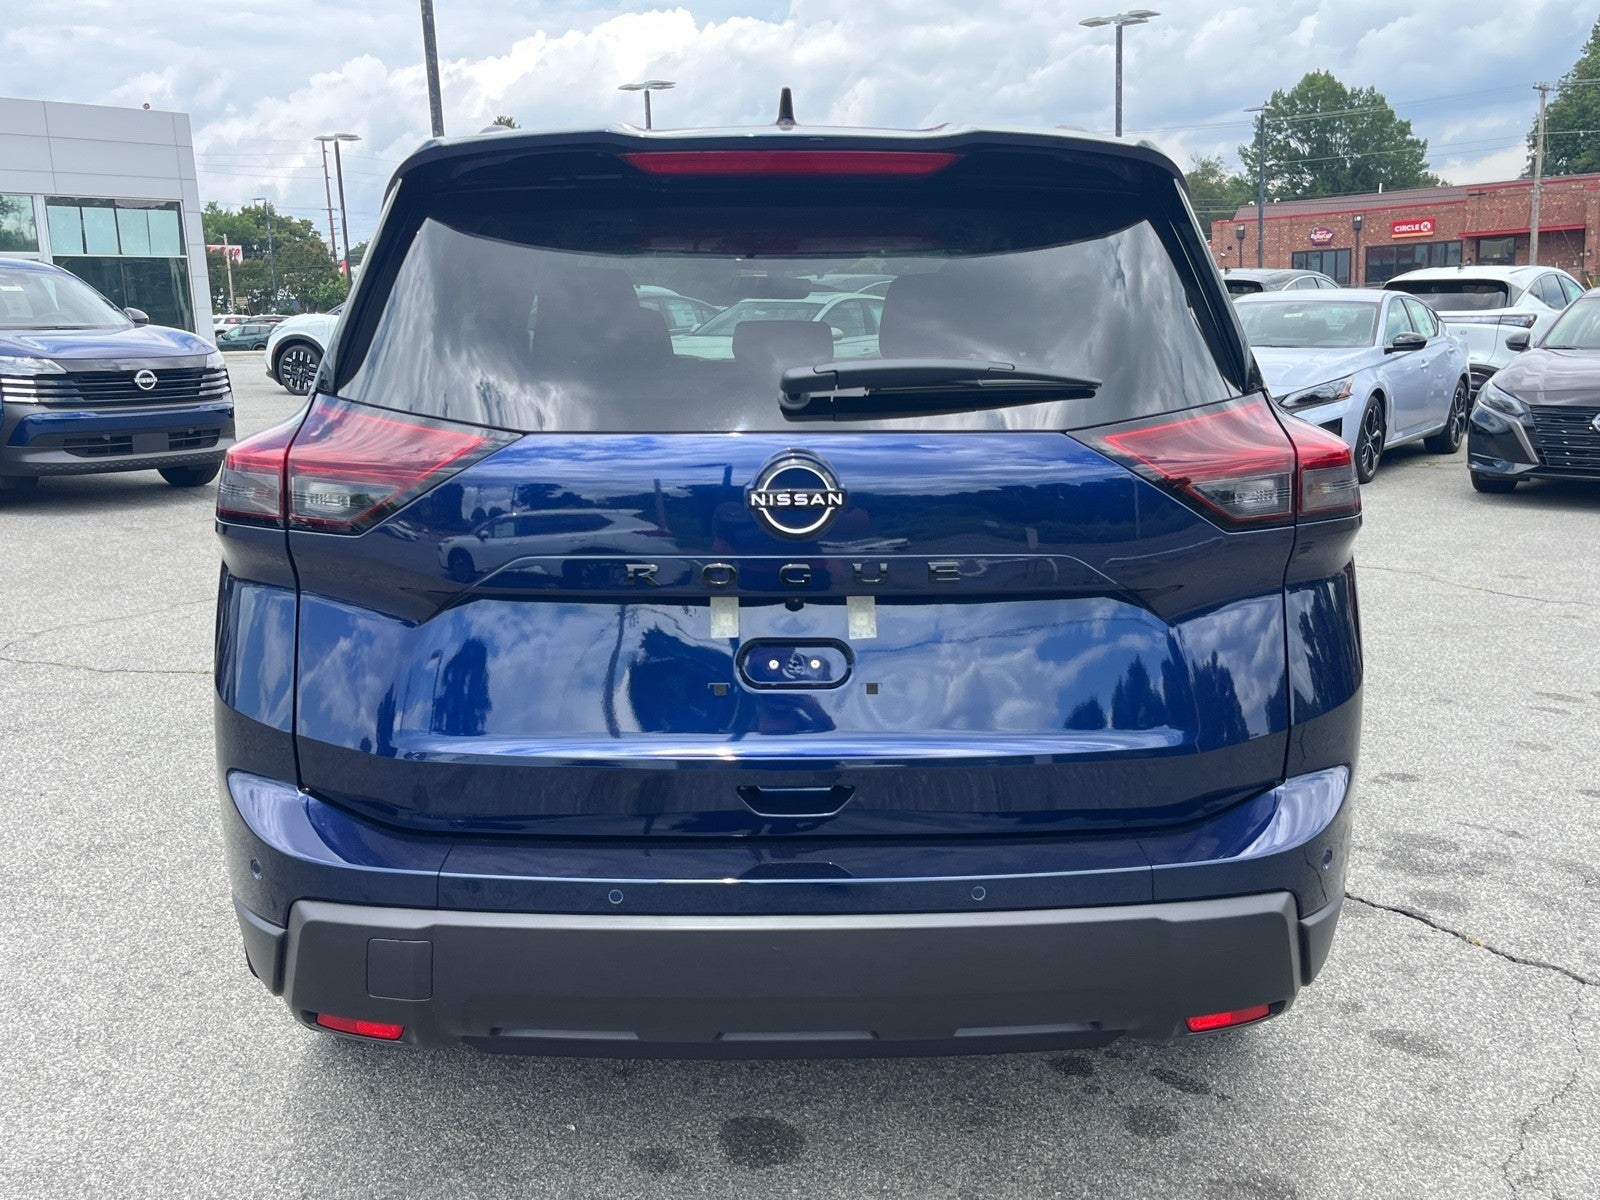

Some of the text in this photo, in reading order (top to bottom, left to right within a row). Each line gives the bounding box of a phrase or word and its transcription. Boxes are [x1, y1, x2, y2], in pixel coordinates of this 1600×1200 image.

[1394, 222, 1430, 232] CIRCLE K
[750, 493, 843, 506] NISSAN
[625, 561, 961, 587] ROGUE
